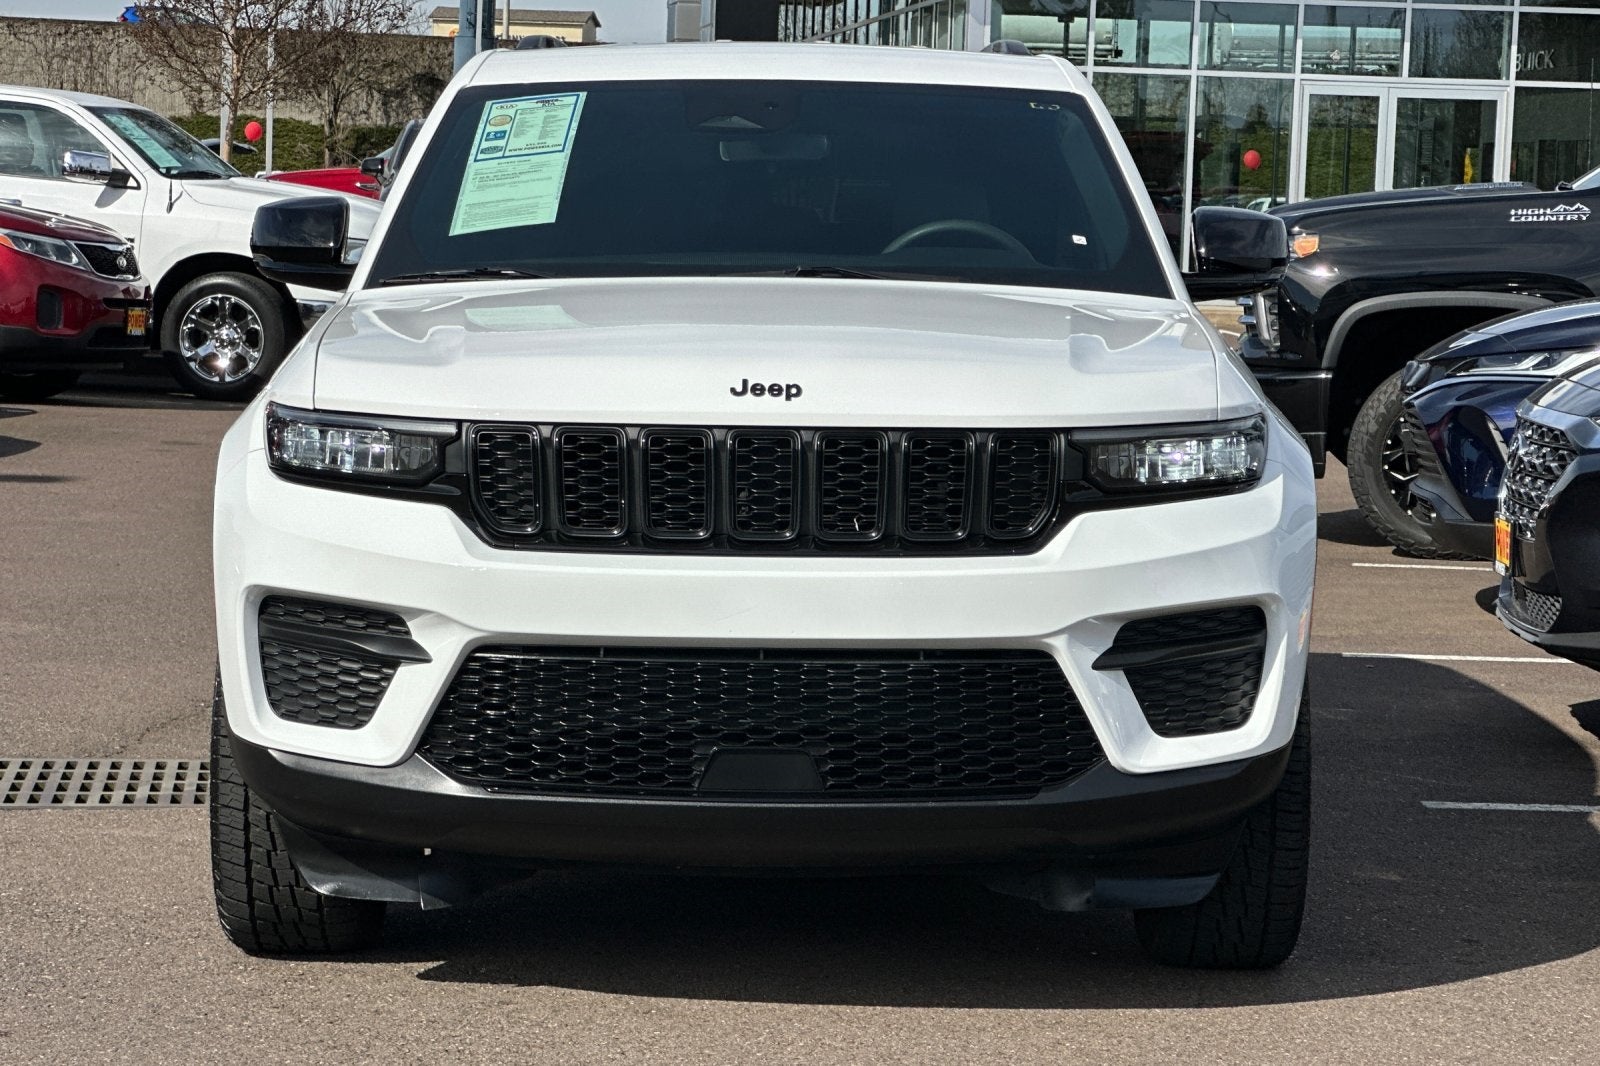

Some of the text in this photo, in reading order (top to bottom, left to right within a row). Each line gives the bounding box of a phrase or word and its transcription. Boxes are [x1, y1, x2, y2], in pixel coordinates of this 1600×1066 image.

[1516, 49, 1554, 72] BUICK
[1510, 214, 1590, 222] COUNTRY
[729, 379, 803, 401] Jeep
